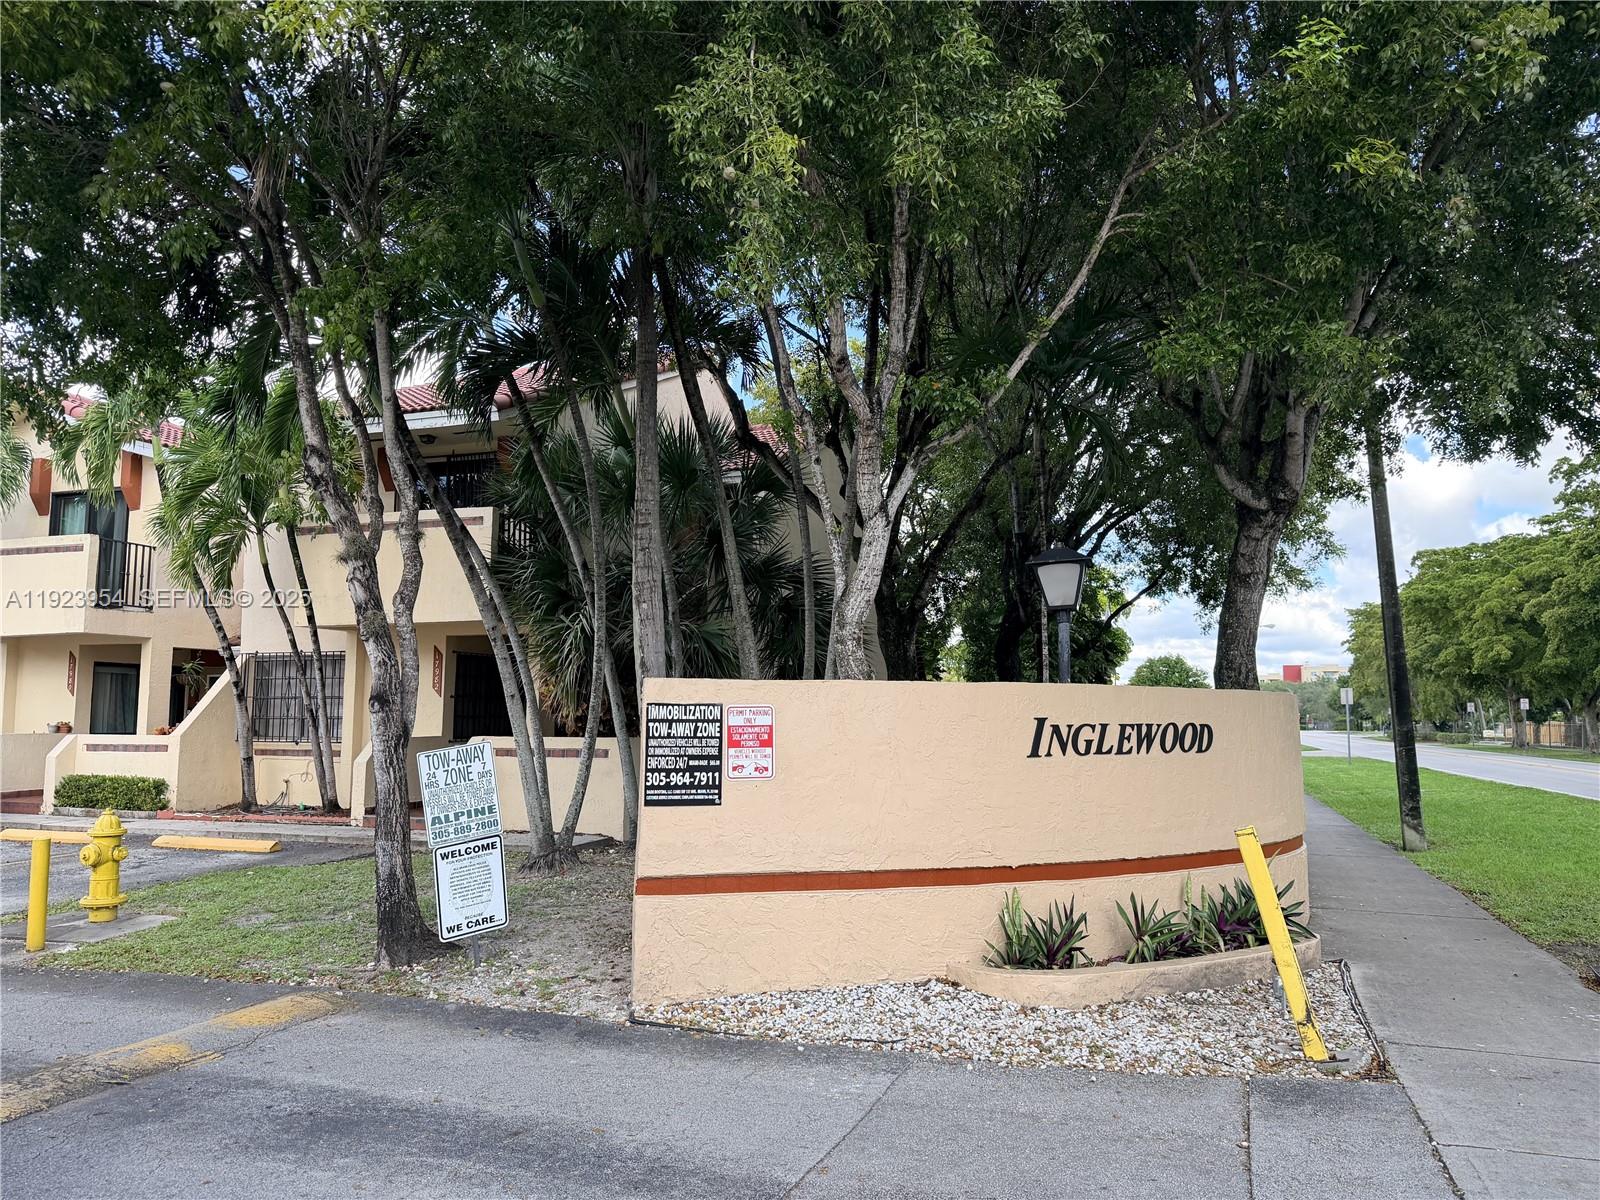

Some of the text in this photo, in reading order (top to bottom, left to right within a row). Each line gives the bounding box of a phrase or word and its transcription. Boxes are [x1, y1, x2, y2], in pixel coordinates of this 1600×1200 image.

[648, 705, 720, 720] IMMOBILIZATION
[648, 722, 720, 737] TOW-AWAY ZONE
[1026, 717, 1214, 758] INGLEWOOD
[425, 745, 485, 771] TOW-AWAY
[648, 757, 688, 769] ENFORCED 24/7
[426, 772, 436, 780] 24
[443, 765, 474, 786] ZONE
[478, 770, 492, 779] DAYS
[646, 772, 719, 786] 305-964-7911
[424, 780, 439, 790] HRS
[463, 780, 484, 792] VEHICLES
[431, 804, 497, 826] ALPINE
[432, 819, 498, 840] 305-889-2800
[440, 841, 498, 860] WELCOME
[446, 923, 463, 934] WE
